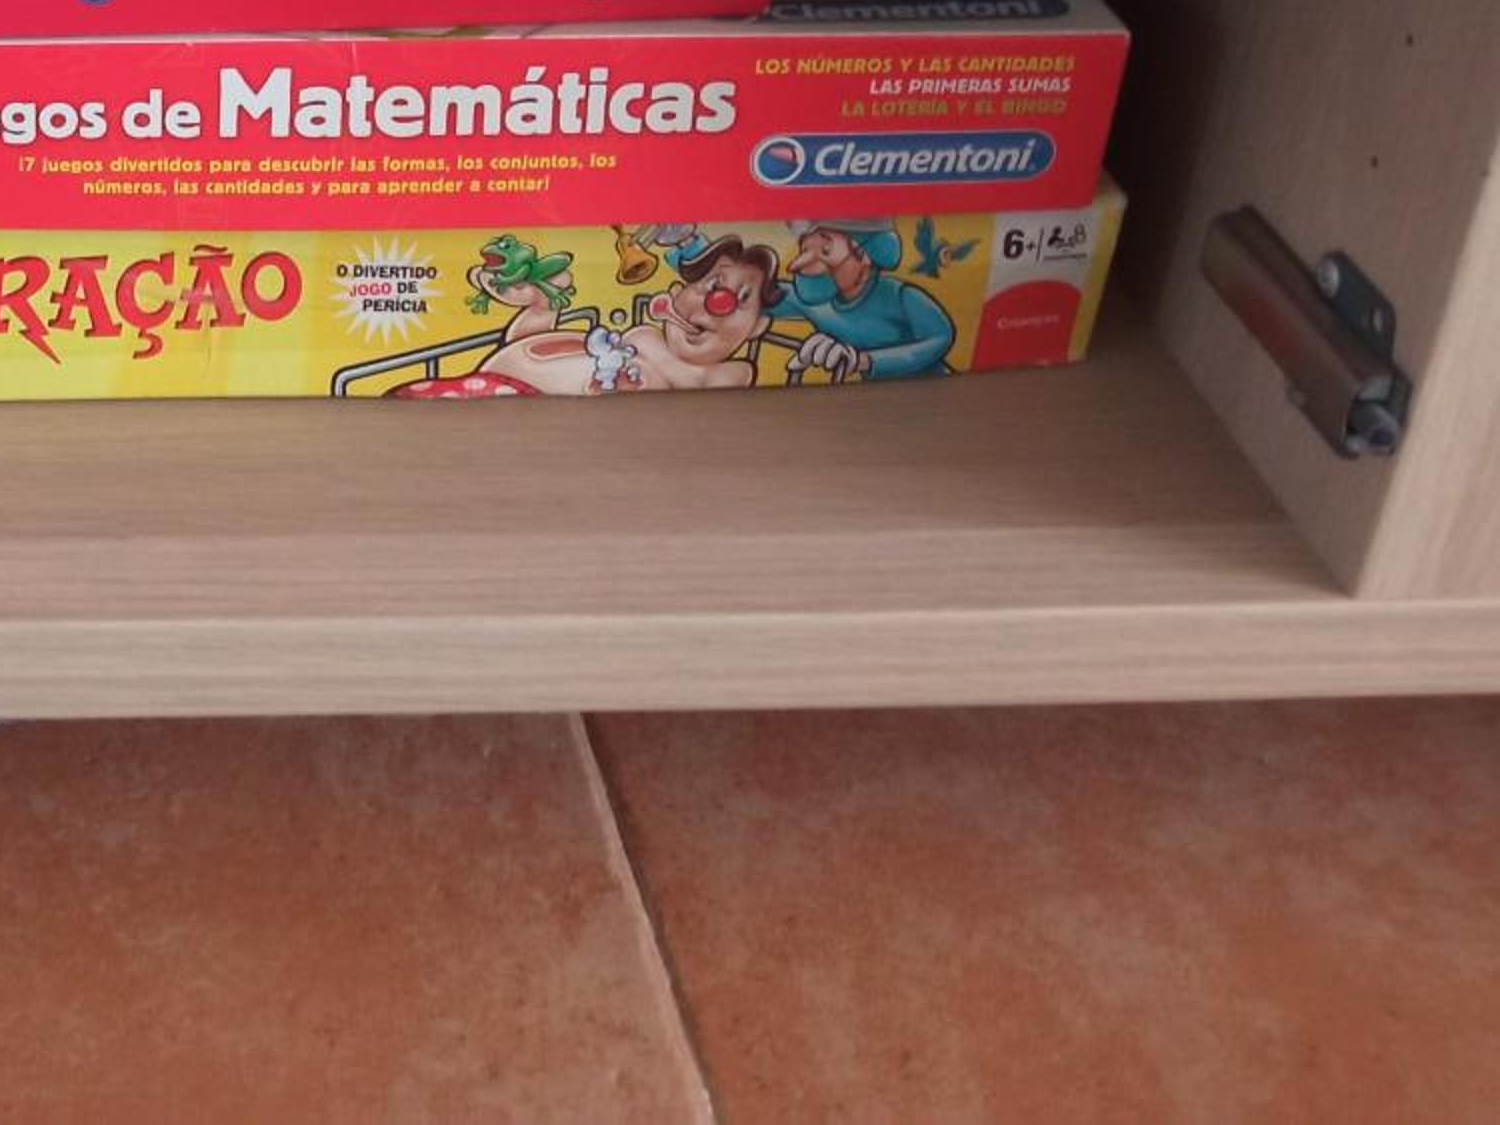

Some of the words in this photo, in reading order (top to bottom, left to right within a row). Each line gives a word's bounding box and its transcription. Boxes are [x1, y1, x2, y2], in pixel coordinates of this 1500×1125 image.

[754, 58, 791, 75] LOS
[795, 53, 893, 75] NÚMEROS
[900, 58, 916, 74] Y
[918, 57, 953, 74] LAS
[957, 55, 1077, 75] CANTIDADES
[868, 78, 903, 95] LAS
[907, 77, 1003, 94] PRIMERAS
[1007, 76, 1073, 93] SUMAS
[121, 88, 201, 139] de
[217, 65, 739, 139] Matemáticas
[840, 100, 866, 117] LA
[41, 155, 105, 175] juegos
[109, 156, 202, 173] divertidos
[208, 158, 253, 174] para
[258, 156, 345, 173] descubrir
[349, 156, 377, 172] las
[383, 154, 452, 174] formas,
[456, 154, 484, 171] los
[489, 153, 586, 172] conjuntos,
[589, 151, 618, 169] los
[814, 140, 1037, 176] Clementoni
[82, 178, 168, 197] números,
[173, 179, 200, 195] las
[205, 178, 306, 196] cantidades
[311, 181, 323, 196] y
[326, 180, 371, 197] para
[376, 177, 464, 196] aprender
[468, 179, 482, 194] a
[336, 264, 348, 277] O
[353, 264, 438, 280] DIVERTIDO
[349, 281, 393, 297] JOGO
[397, 280, 419, 294] DE
[362, 296, 428, 313] PERÍCIA
